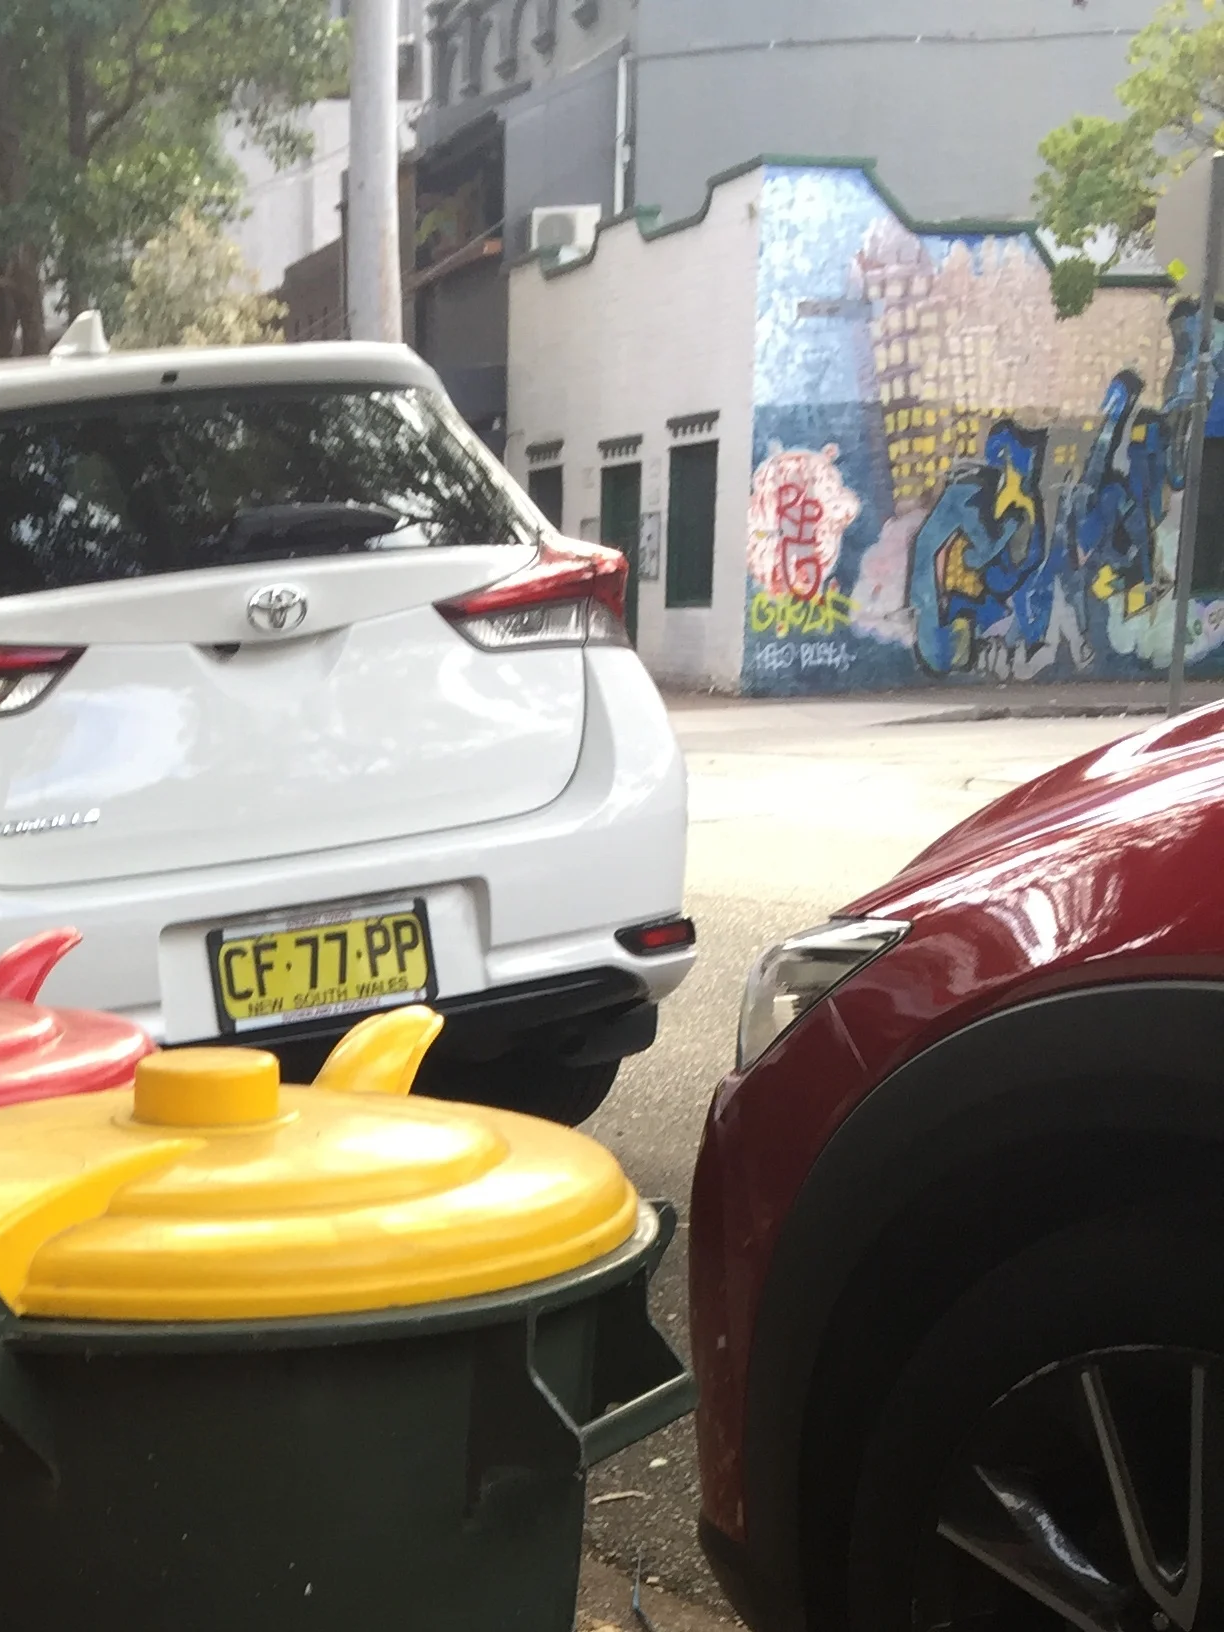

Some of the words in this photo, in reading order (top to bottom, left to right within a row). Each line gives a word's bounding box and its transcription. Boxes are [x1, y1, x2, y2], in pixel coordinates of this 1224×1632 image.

[247, 996, 284, 1017] NEW
[293, 987, 348, 1009] SOUTH
[355, 975, 409, 998] WALES
